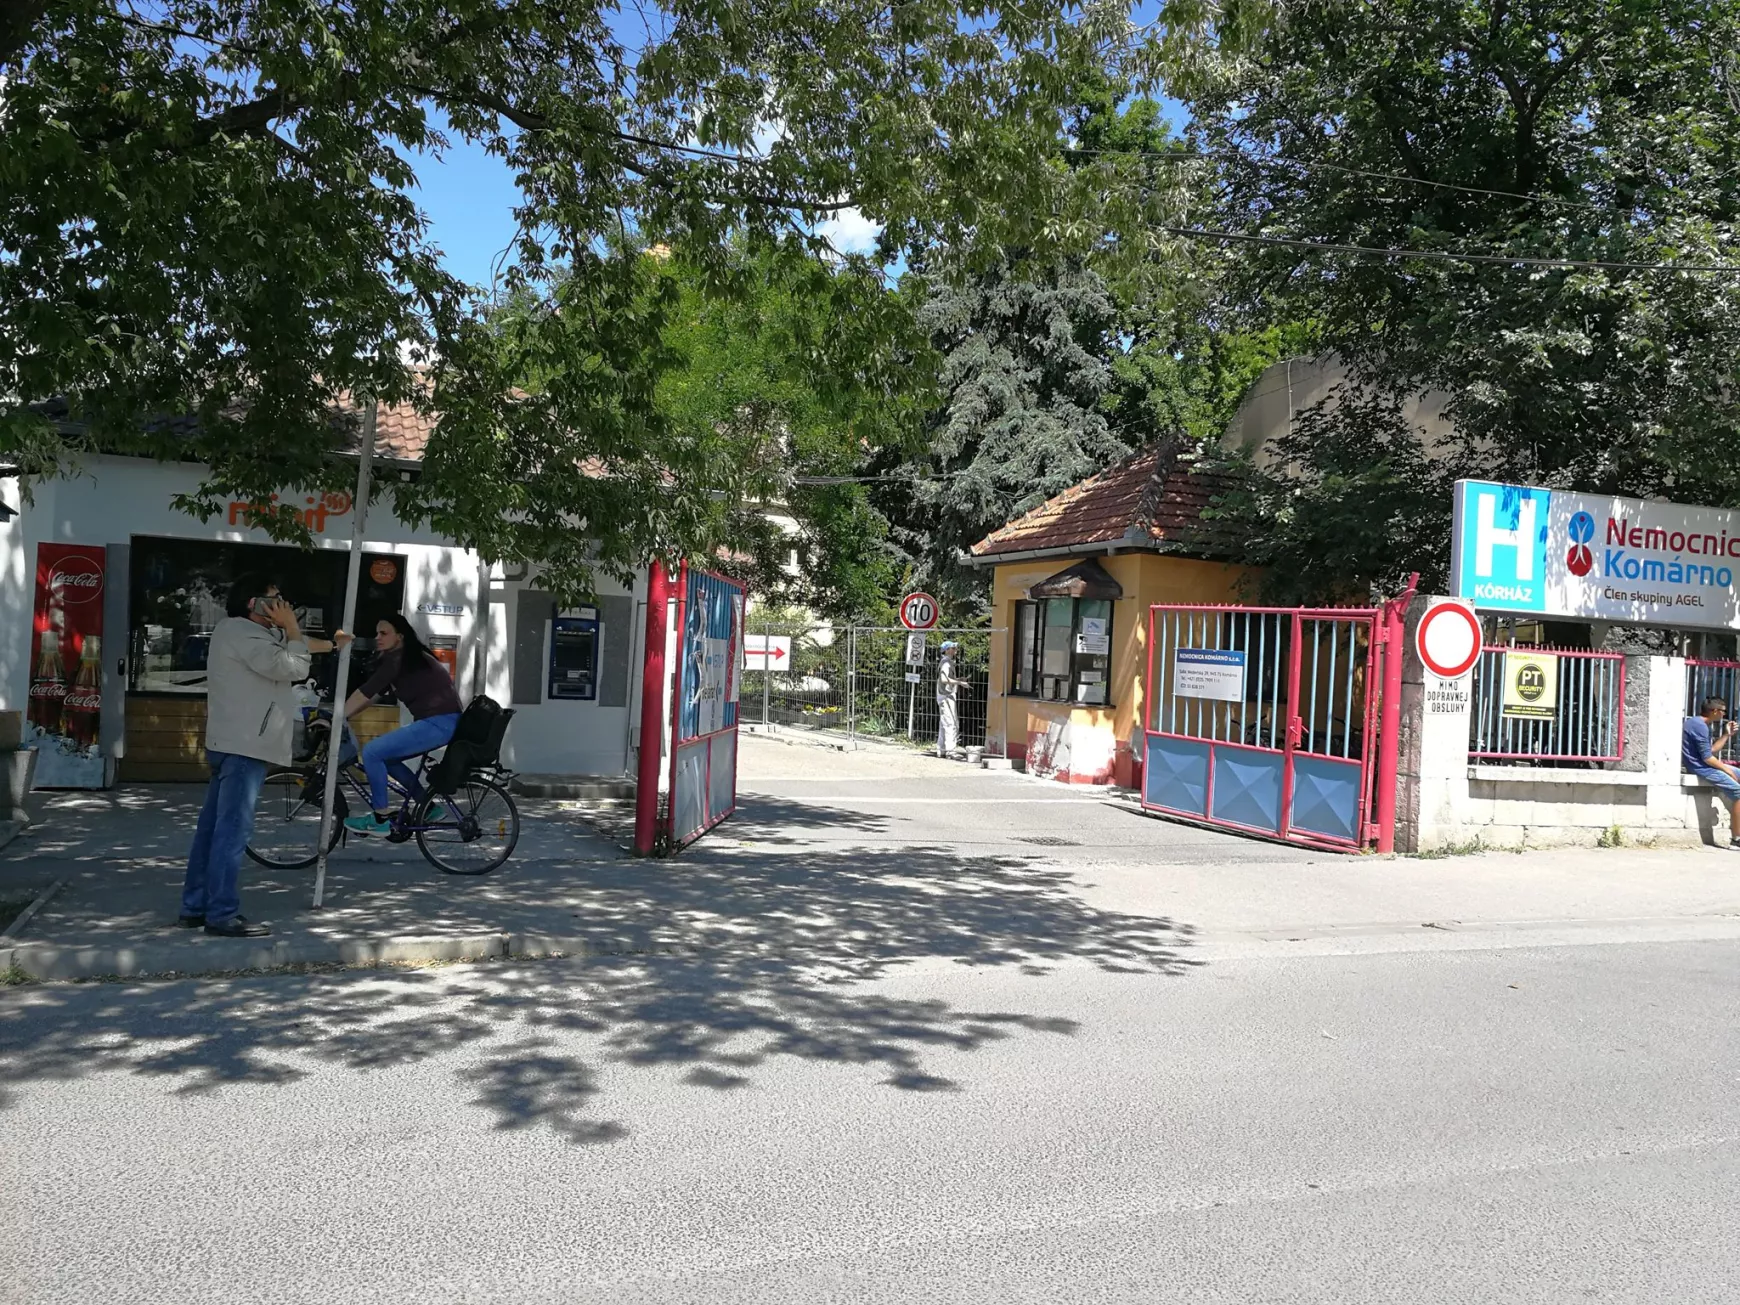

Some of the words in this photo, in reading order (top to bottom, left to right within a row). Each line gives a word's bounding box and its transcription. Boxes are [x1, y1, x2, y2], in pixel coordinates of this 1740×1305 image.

[1475, 493, 1537, 580] H
[1604, 549, 1733, 588] Komárno
[51, 571, 101, 587] Coca-Cola
[1474, 583, 1533, 602] KÓRHÁZ
[1604, 586, 1628, 601] Člen
[1630, 592, 1672, 607] skupiny
[1675, 594, 1704, 607] AGEL
[427, 604, 464, 614] VSTUP
[910, 604, 931, 622] 10
[1439, 681, 1458, 691] MIMO
[1522, 670, 1540, 686] PT
[1427, 691, 1469, 702] DOPRAVNEJ
[1431, 702, 1465, 713] OBSLUHY
